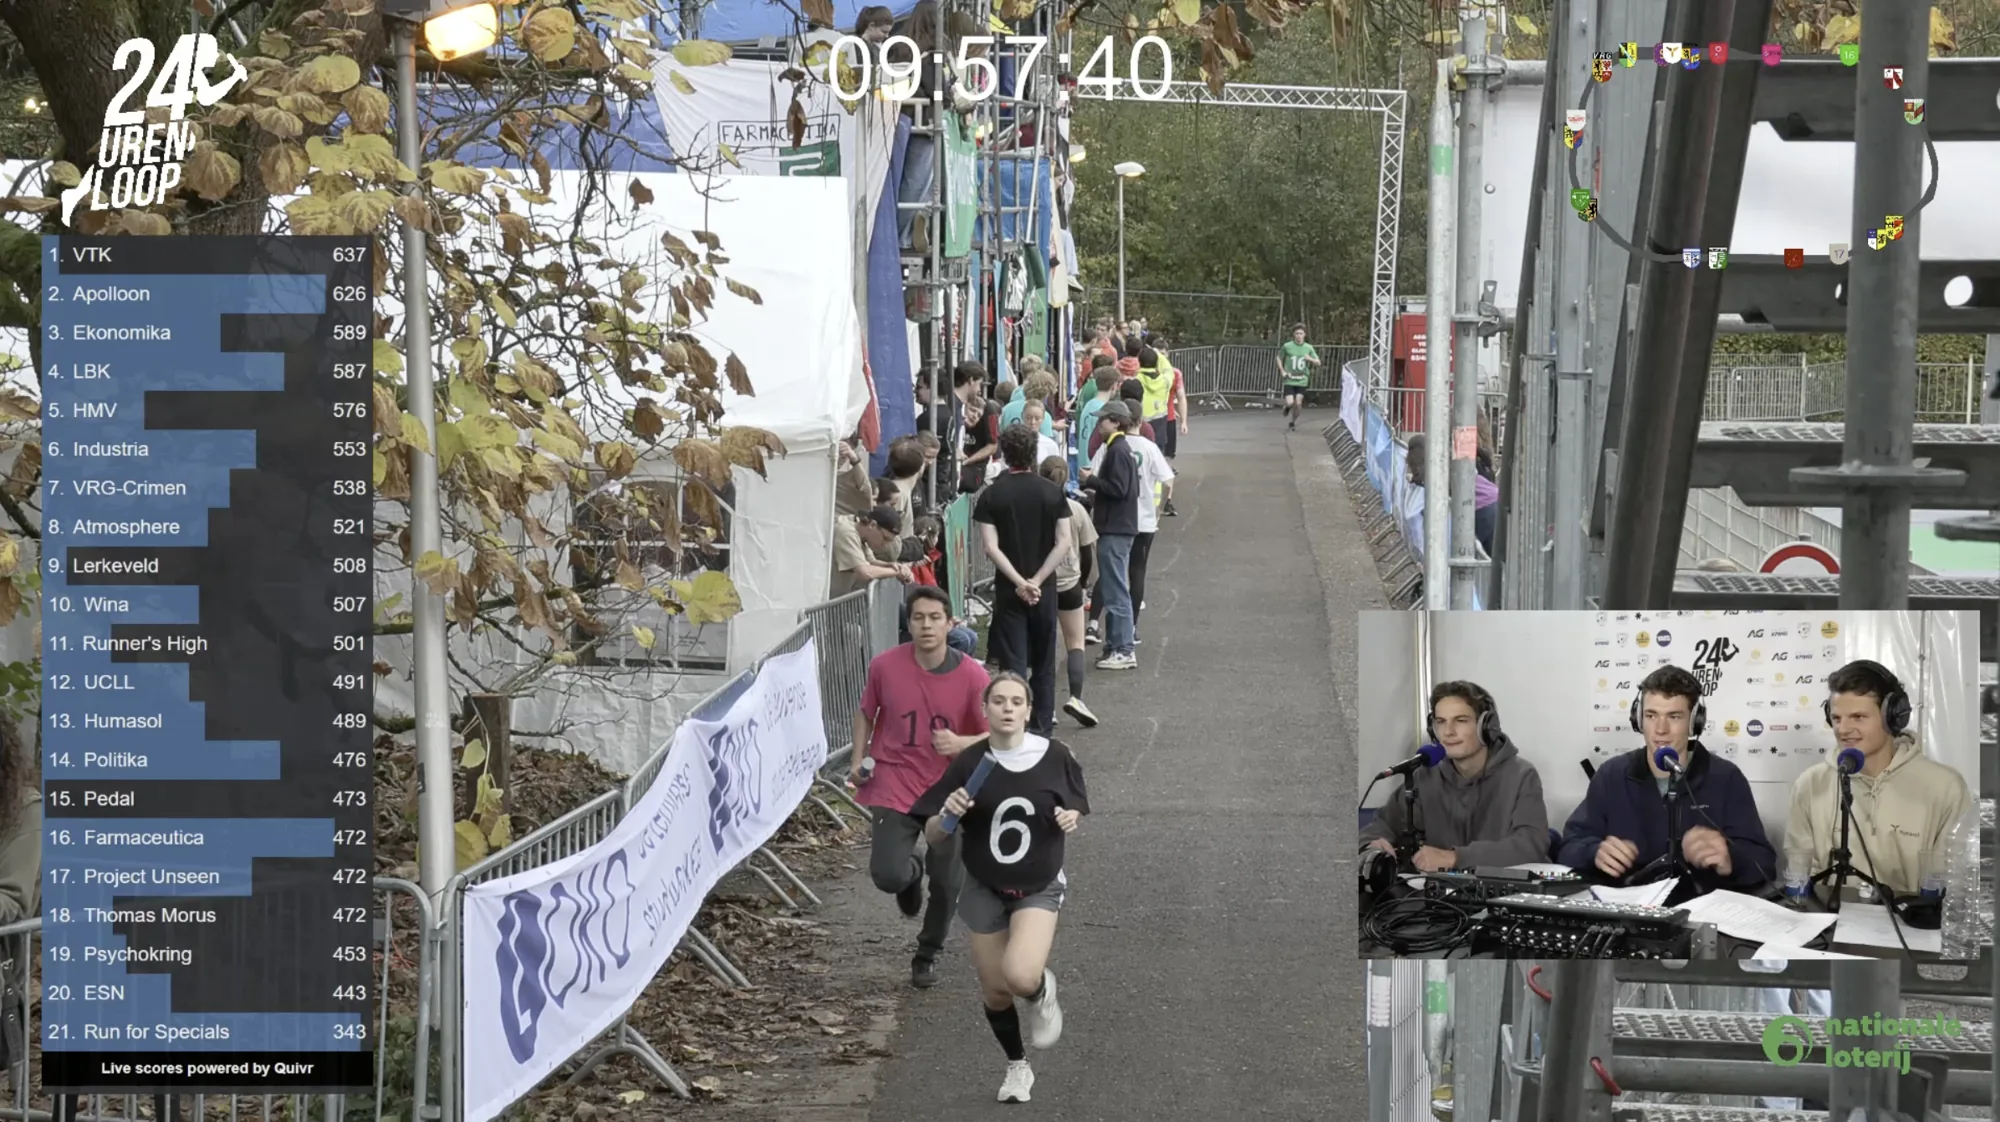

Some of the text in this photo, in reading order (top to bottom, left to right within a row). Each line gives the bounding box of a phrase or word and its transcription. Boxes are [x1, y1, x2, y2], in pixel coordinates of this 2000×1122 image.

[1290, 355, 1306, 371] 16
[1692, 637, 1722, 671] 24
[1702, 682, 1718, 697] OP
[989, 796, 1036, 865] 6
